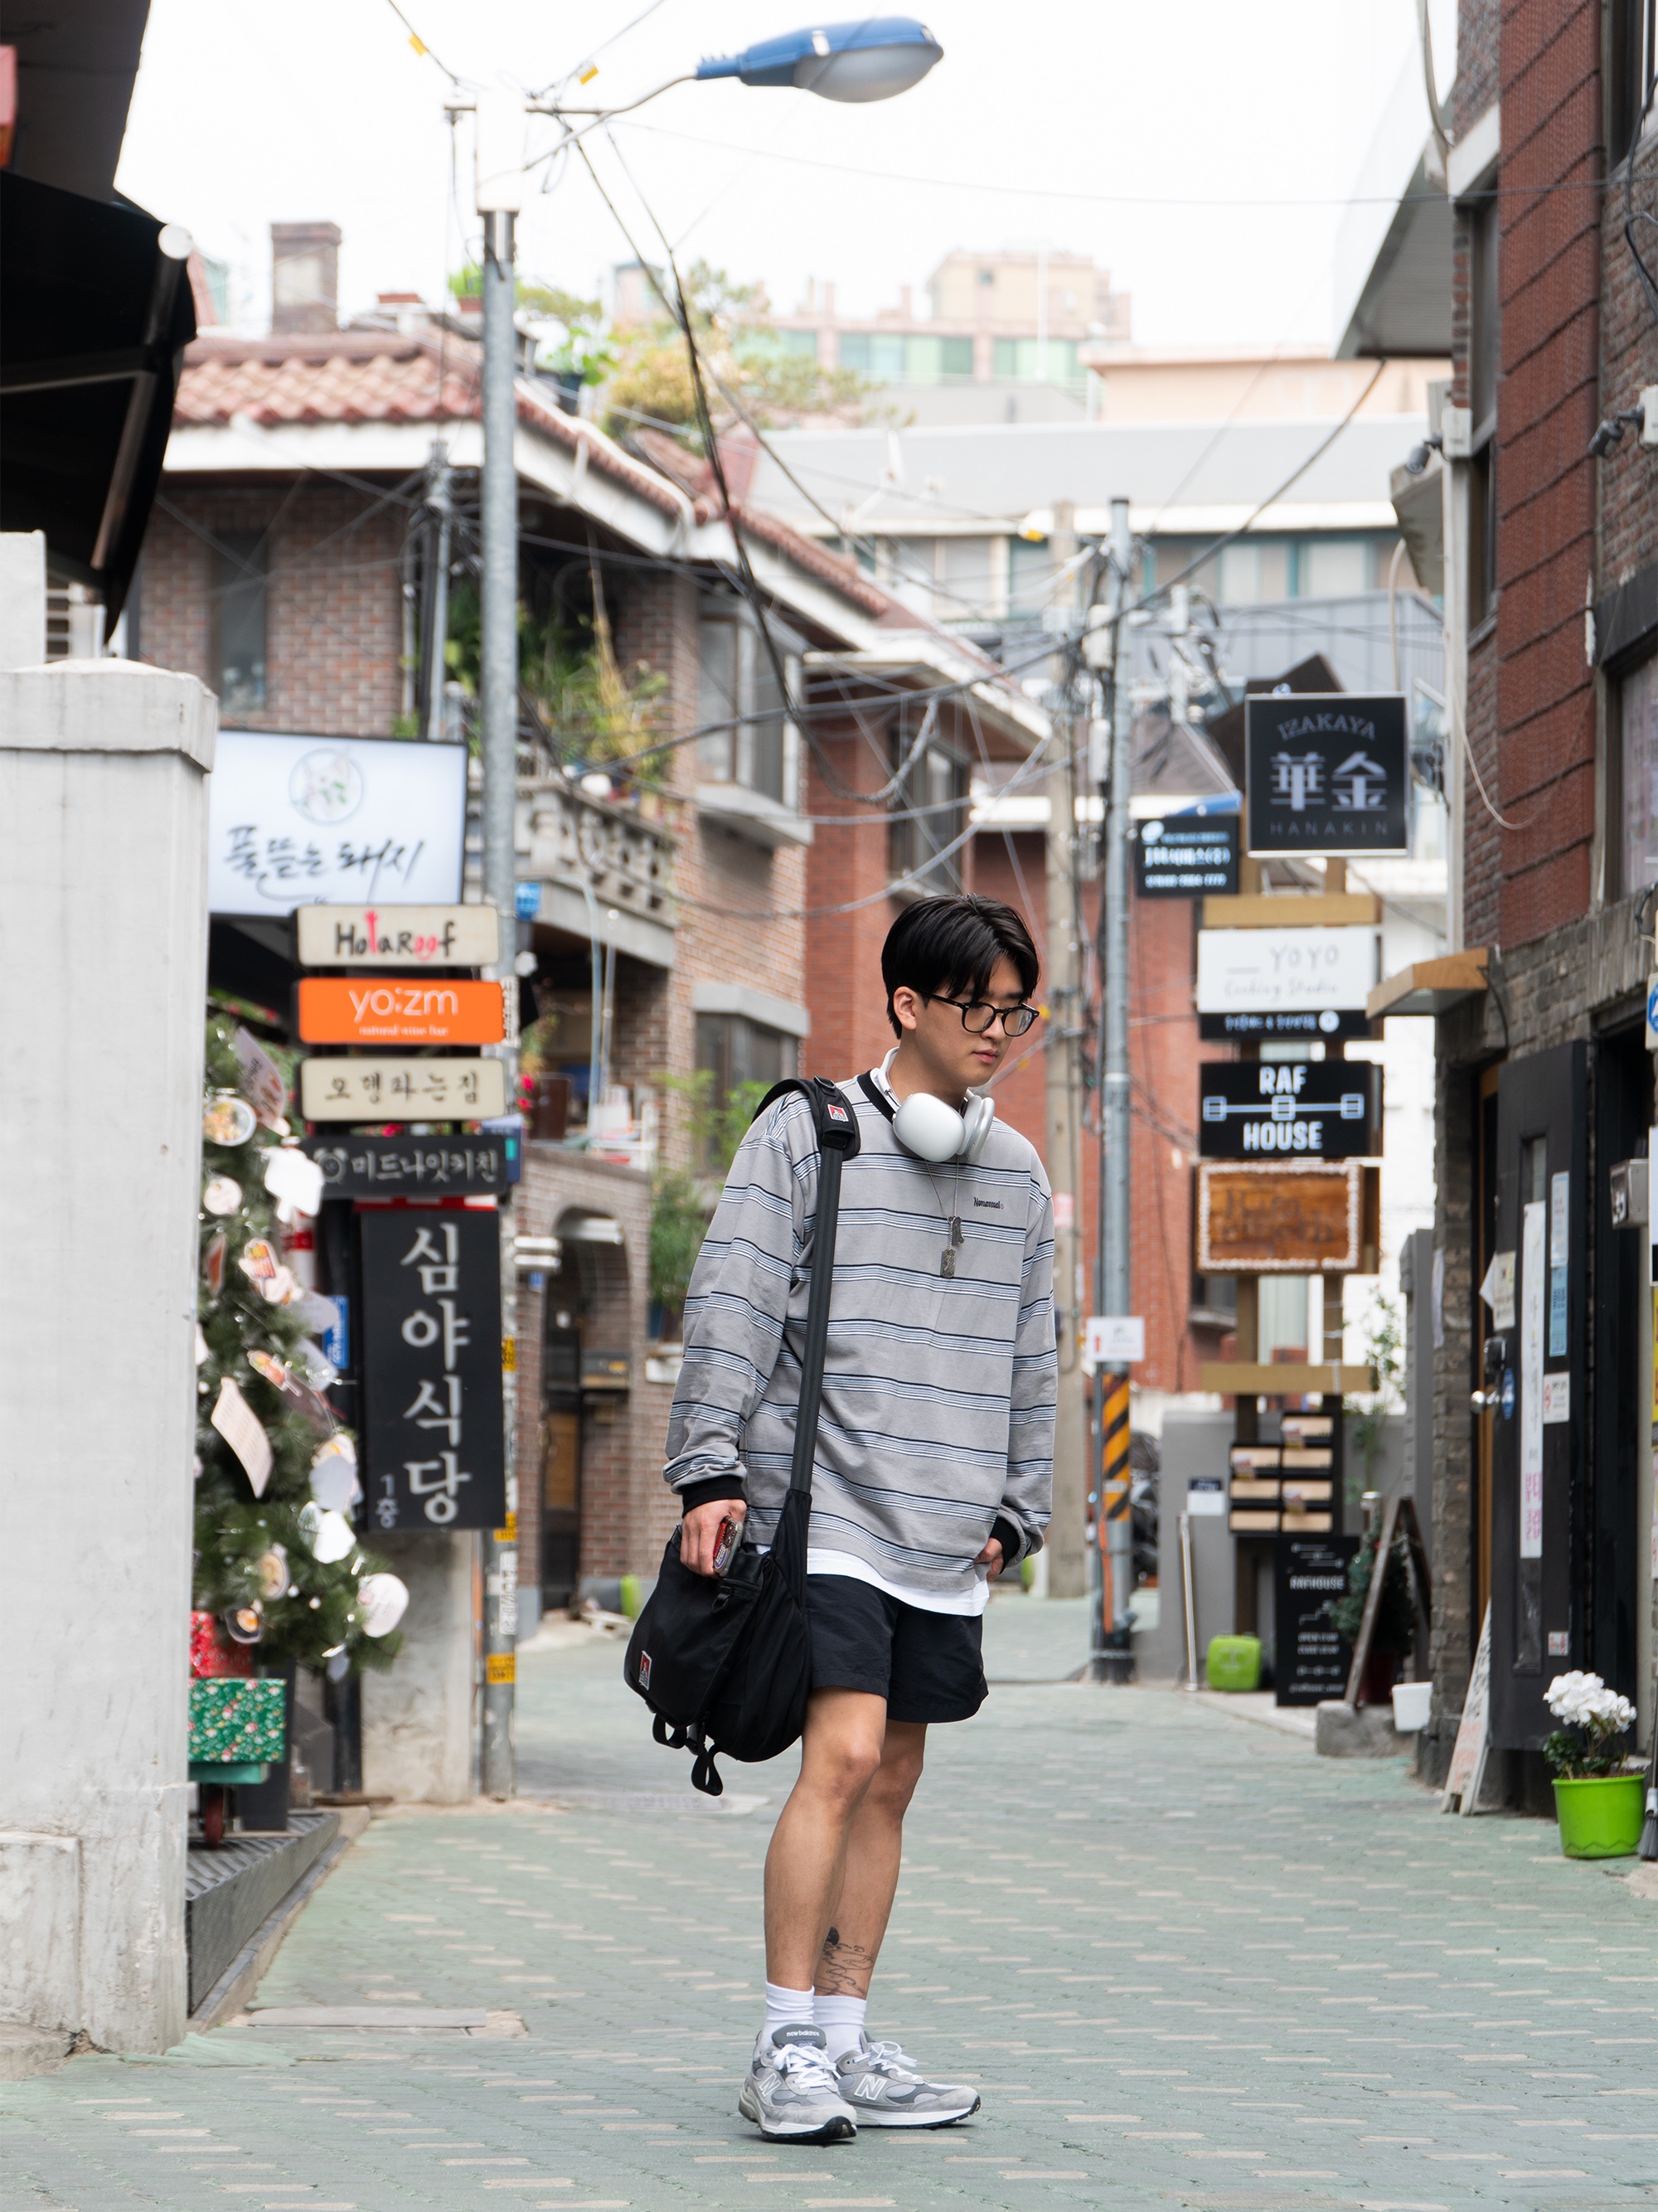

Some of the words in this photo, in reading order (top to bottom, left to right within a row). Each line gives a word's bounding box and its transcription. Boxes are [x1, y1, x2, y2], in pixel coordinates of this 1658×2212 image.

[1276, 712, 1376, 741] IZAKAYA
[1270, 750, 1388, 812] 華金
[1269, 821, 1388, 836] HANAKIN
[1268, 943, 1340, 973] YOYO
[358, 1023, 400, 1036] natural
[1258, 1065, 1308, 1095] RAF
[1243, 1120, 1324, 1151] HOUSE
[400, 1221, 472, 1525] 심야식당
[376, 1472, 400, 1530] 1층
[853, 2074, 888, 2101] N
